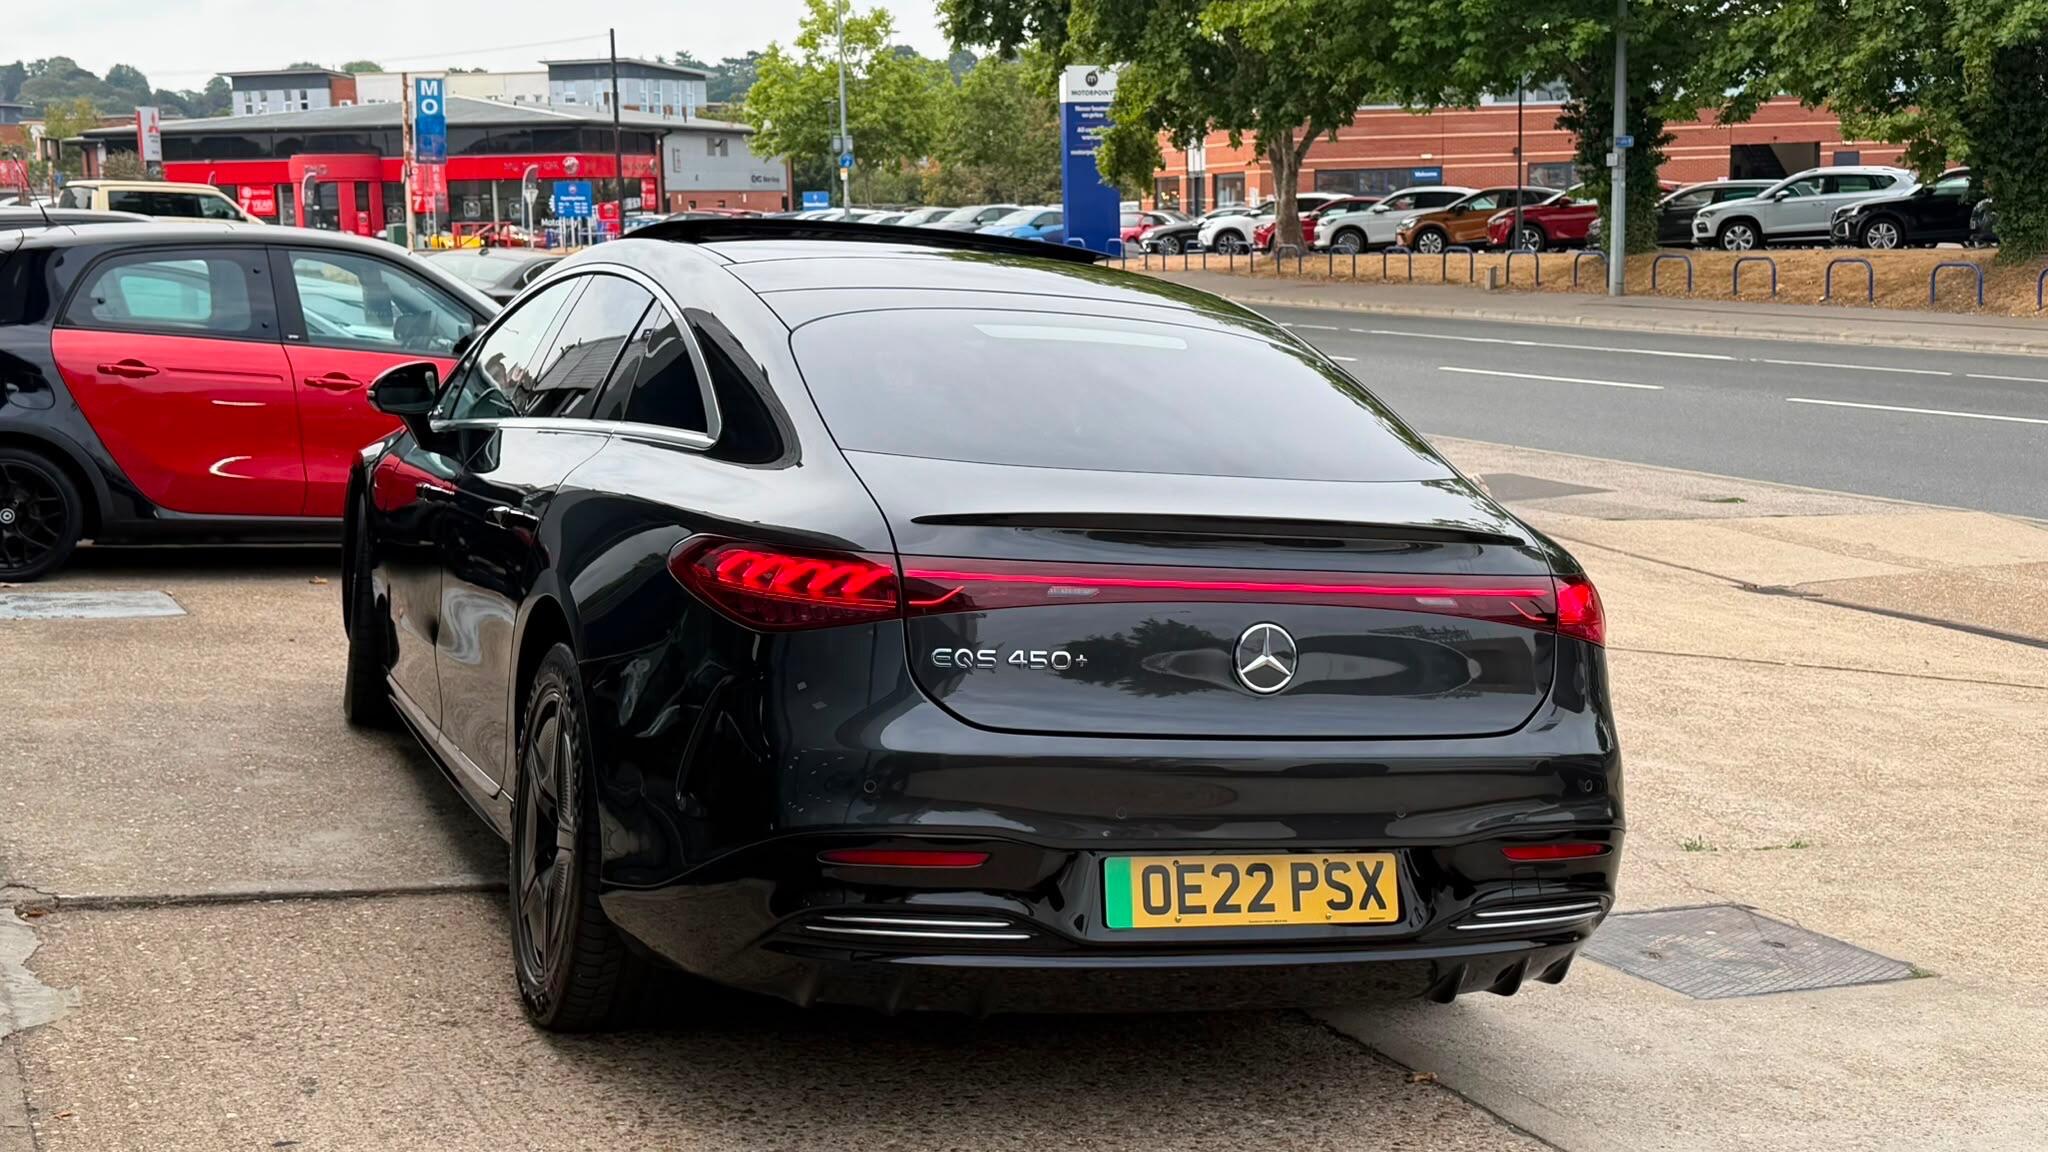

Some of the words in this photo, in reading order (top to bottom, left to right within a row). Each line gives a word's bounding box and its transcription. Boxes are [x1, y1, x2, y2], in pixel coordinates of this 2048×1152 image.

[420, 79, 439, 115] MO
[931, 648, 997, 669] EQS
[1008, 650, 1088, 670] 450+
[1141, 862, 1276, 915] OE22
[1290, 860, 1387, 912] PSX
